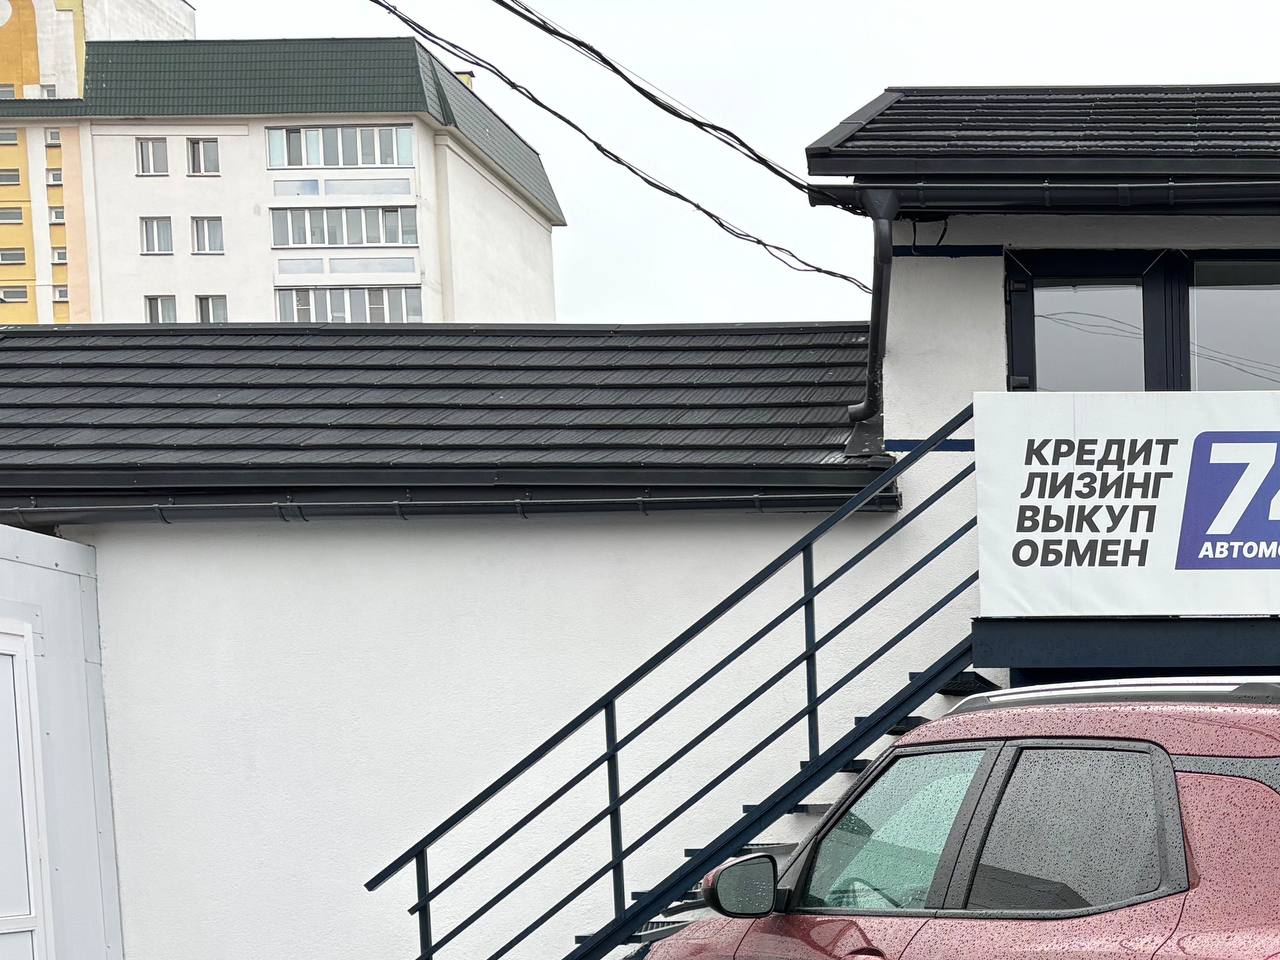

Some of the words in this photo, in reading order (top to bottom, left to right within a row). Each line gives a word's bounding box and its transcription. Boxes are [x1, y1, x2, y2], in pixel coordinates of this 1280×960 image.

[1024, 438, 1179, 471] КРЕДИТ
[1020, 471, 1174, 499] ЛИЗИНГ
[1016, 504, 1157, 533] ВЫКУП
[1011, 538, 1149, 567] ОБМЕН
